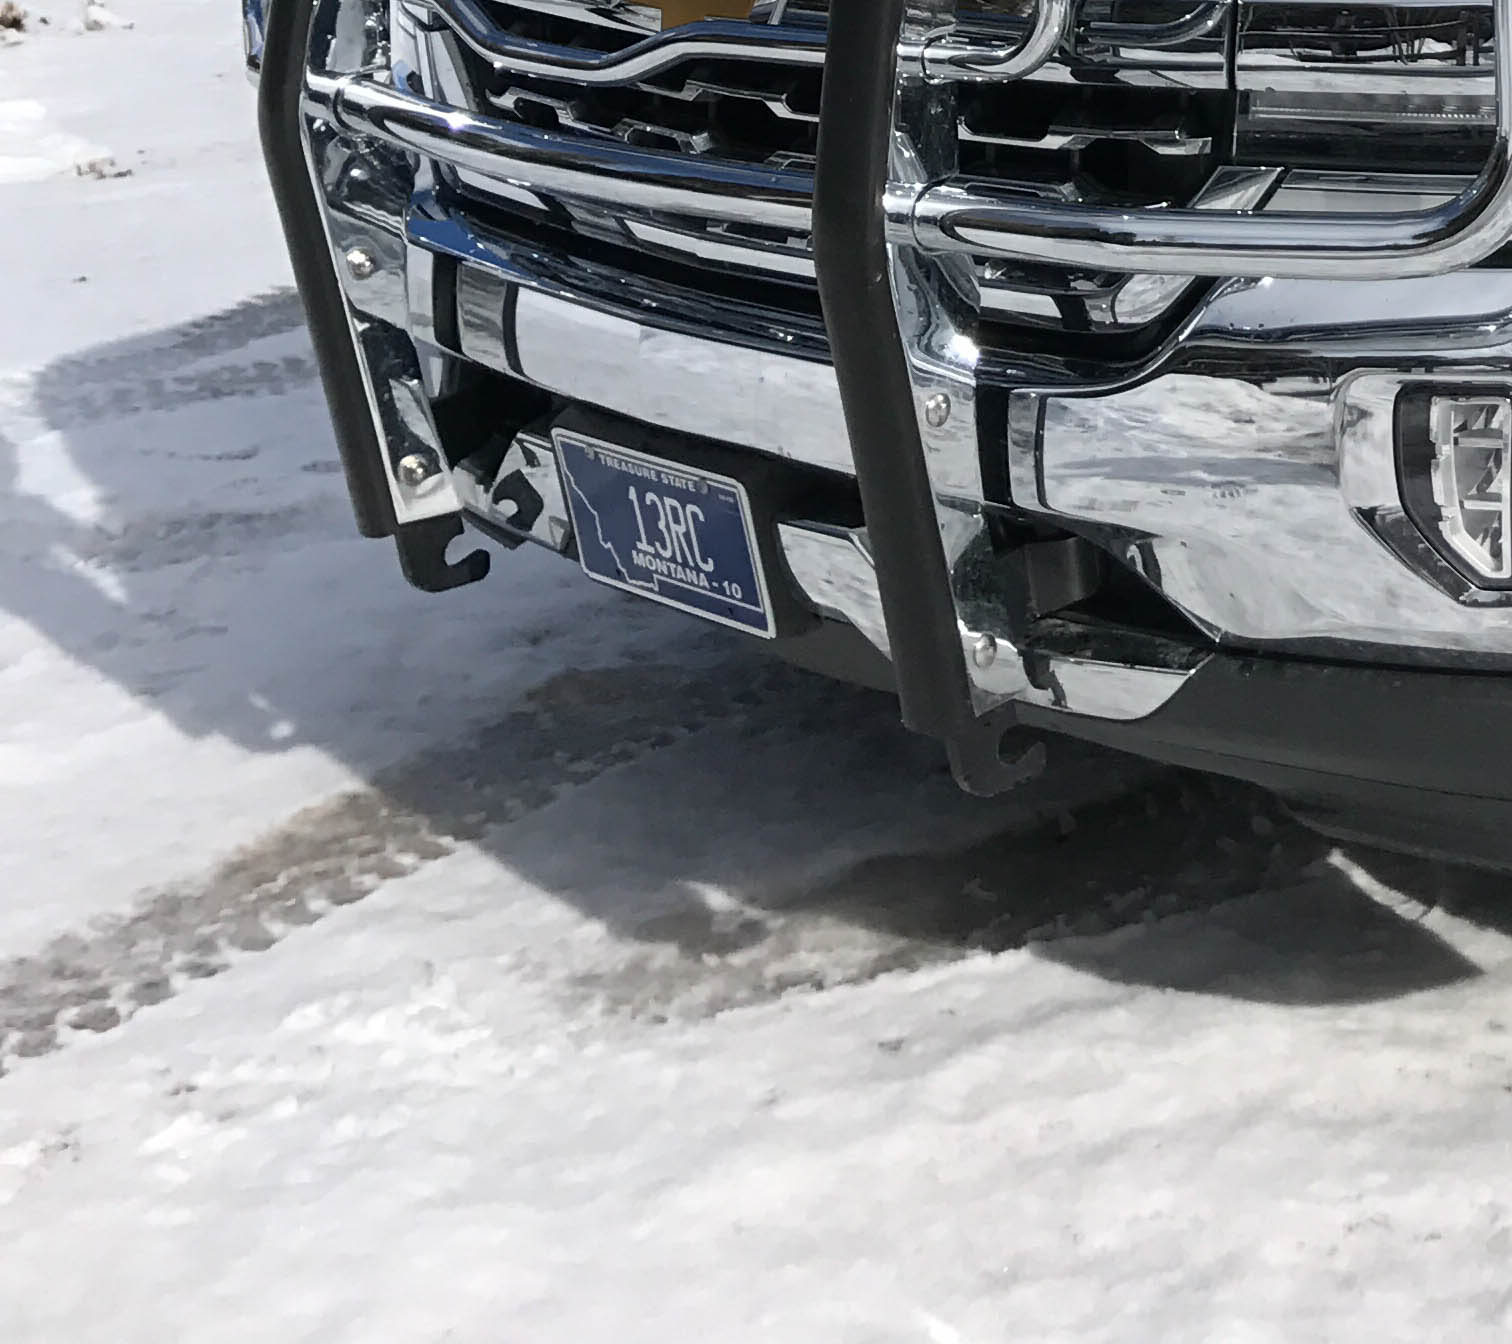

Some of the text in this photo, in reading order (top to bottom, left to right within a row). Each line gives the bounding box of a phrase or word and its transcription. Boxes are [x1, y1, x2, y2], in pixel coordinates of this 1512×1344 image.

[598, 452, 696, 492] TREASURE STATE
[628, 485, 714, 572] 13RC
[631, 549, 711, 590] MONTANA
[722, 580, 743, 599] 10
